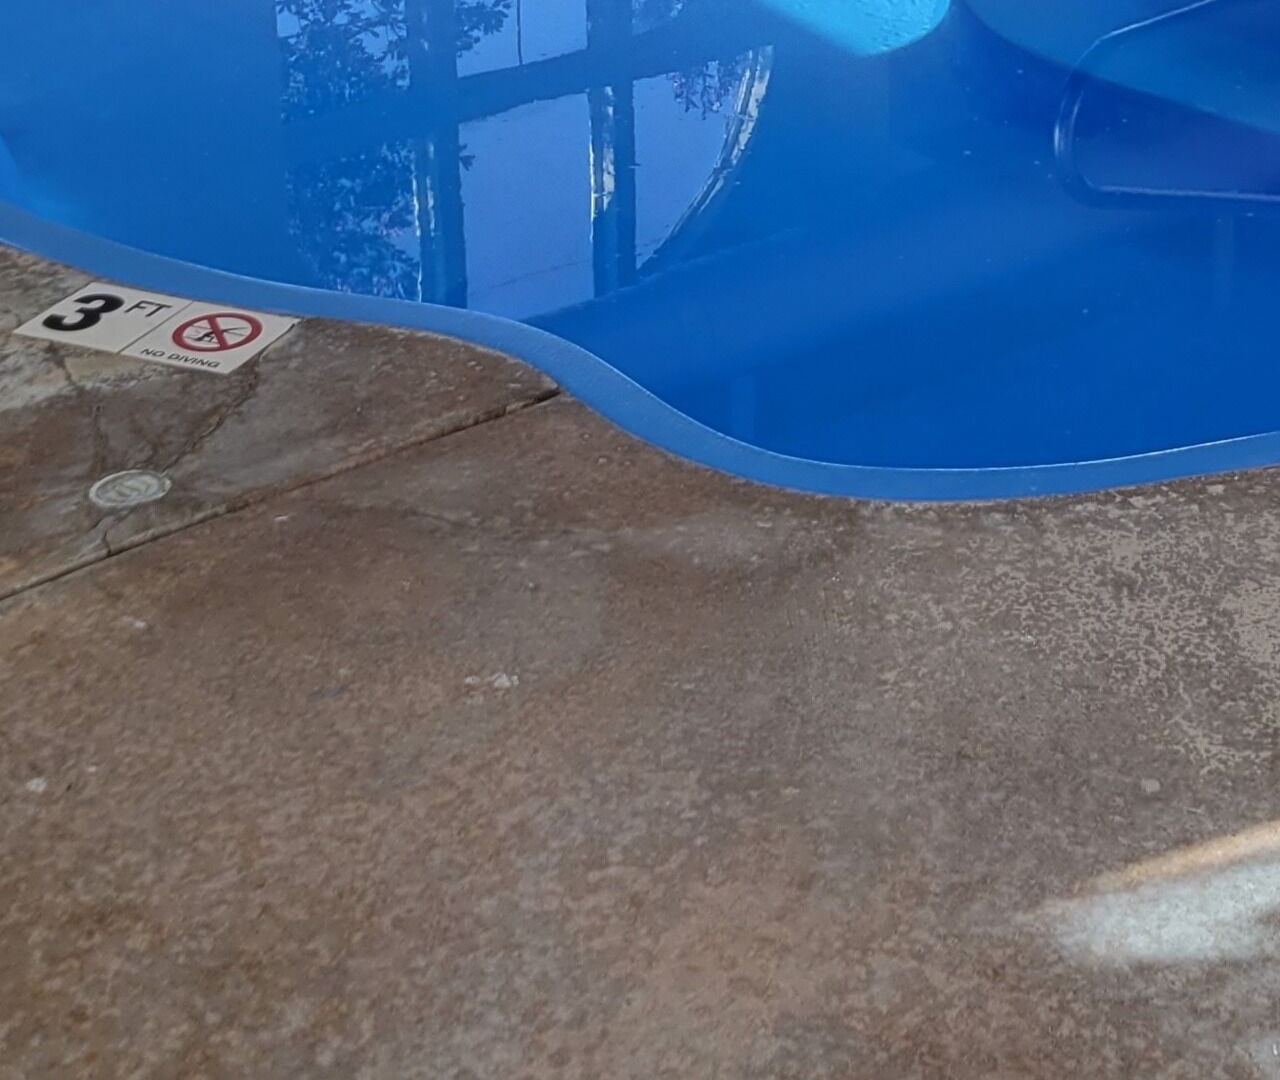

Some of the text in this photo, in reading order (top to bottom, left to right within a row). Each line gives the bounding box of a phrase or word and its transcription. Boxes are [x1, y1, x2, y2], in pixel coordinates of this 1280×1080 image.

[41, 293, 174, 332] 3 FT
[139, 347, 222, 370] NO DIVING
